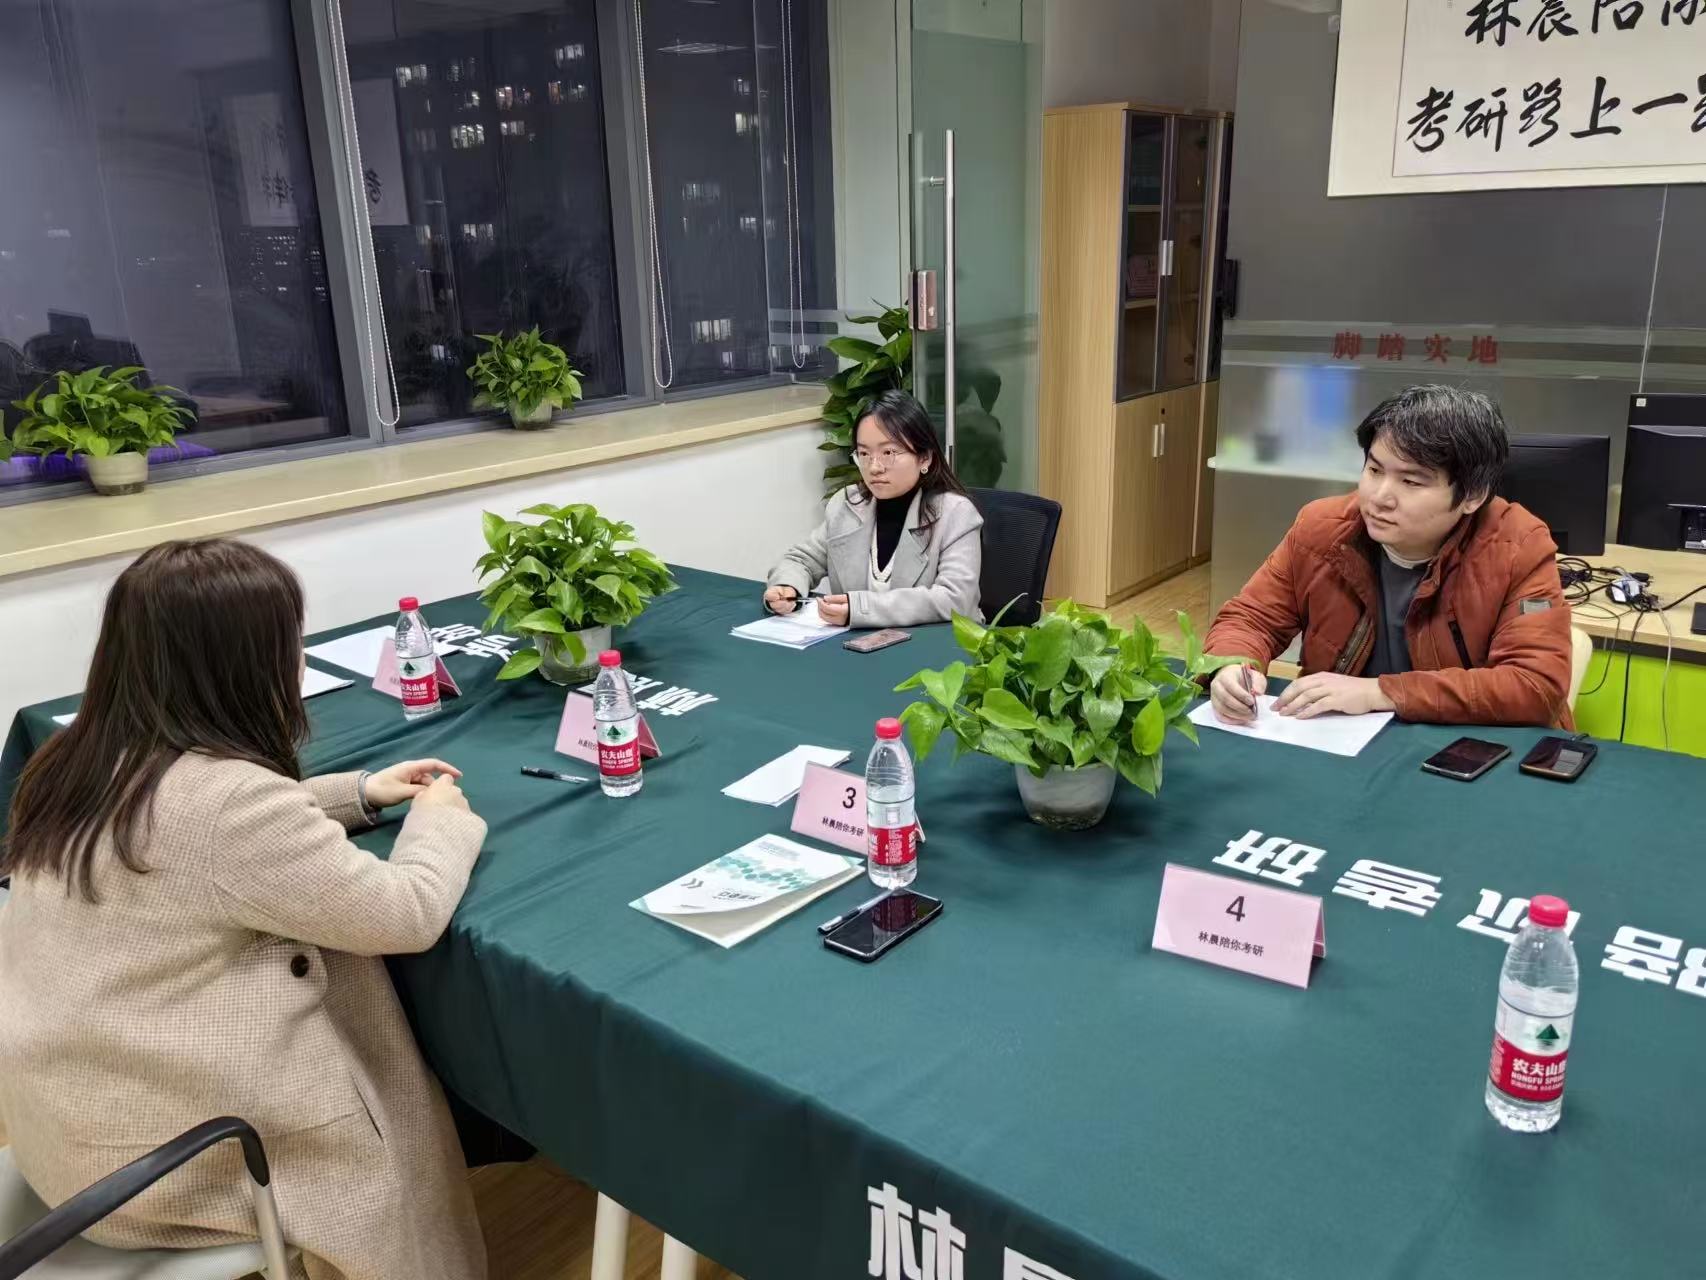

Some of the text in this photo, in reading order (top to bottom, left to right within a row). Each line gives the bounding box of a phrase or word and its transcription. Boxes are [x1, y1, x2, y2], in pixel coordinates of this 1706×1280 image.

[1332, 330, 1499, 364] 脚踏实地
[842, 786, 857, 809] 3
[821, 816, 865, 837] 林晨陪你考研
[1225, 895, 1246, 922] 4
[1198, 930, 1264, 957] 林晨陪你考研
